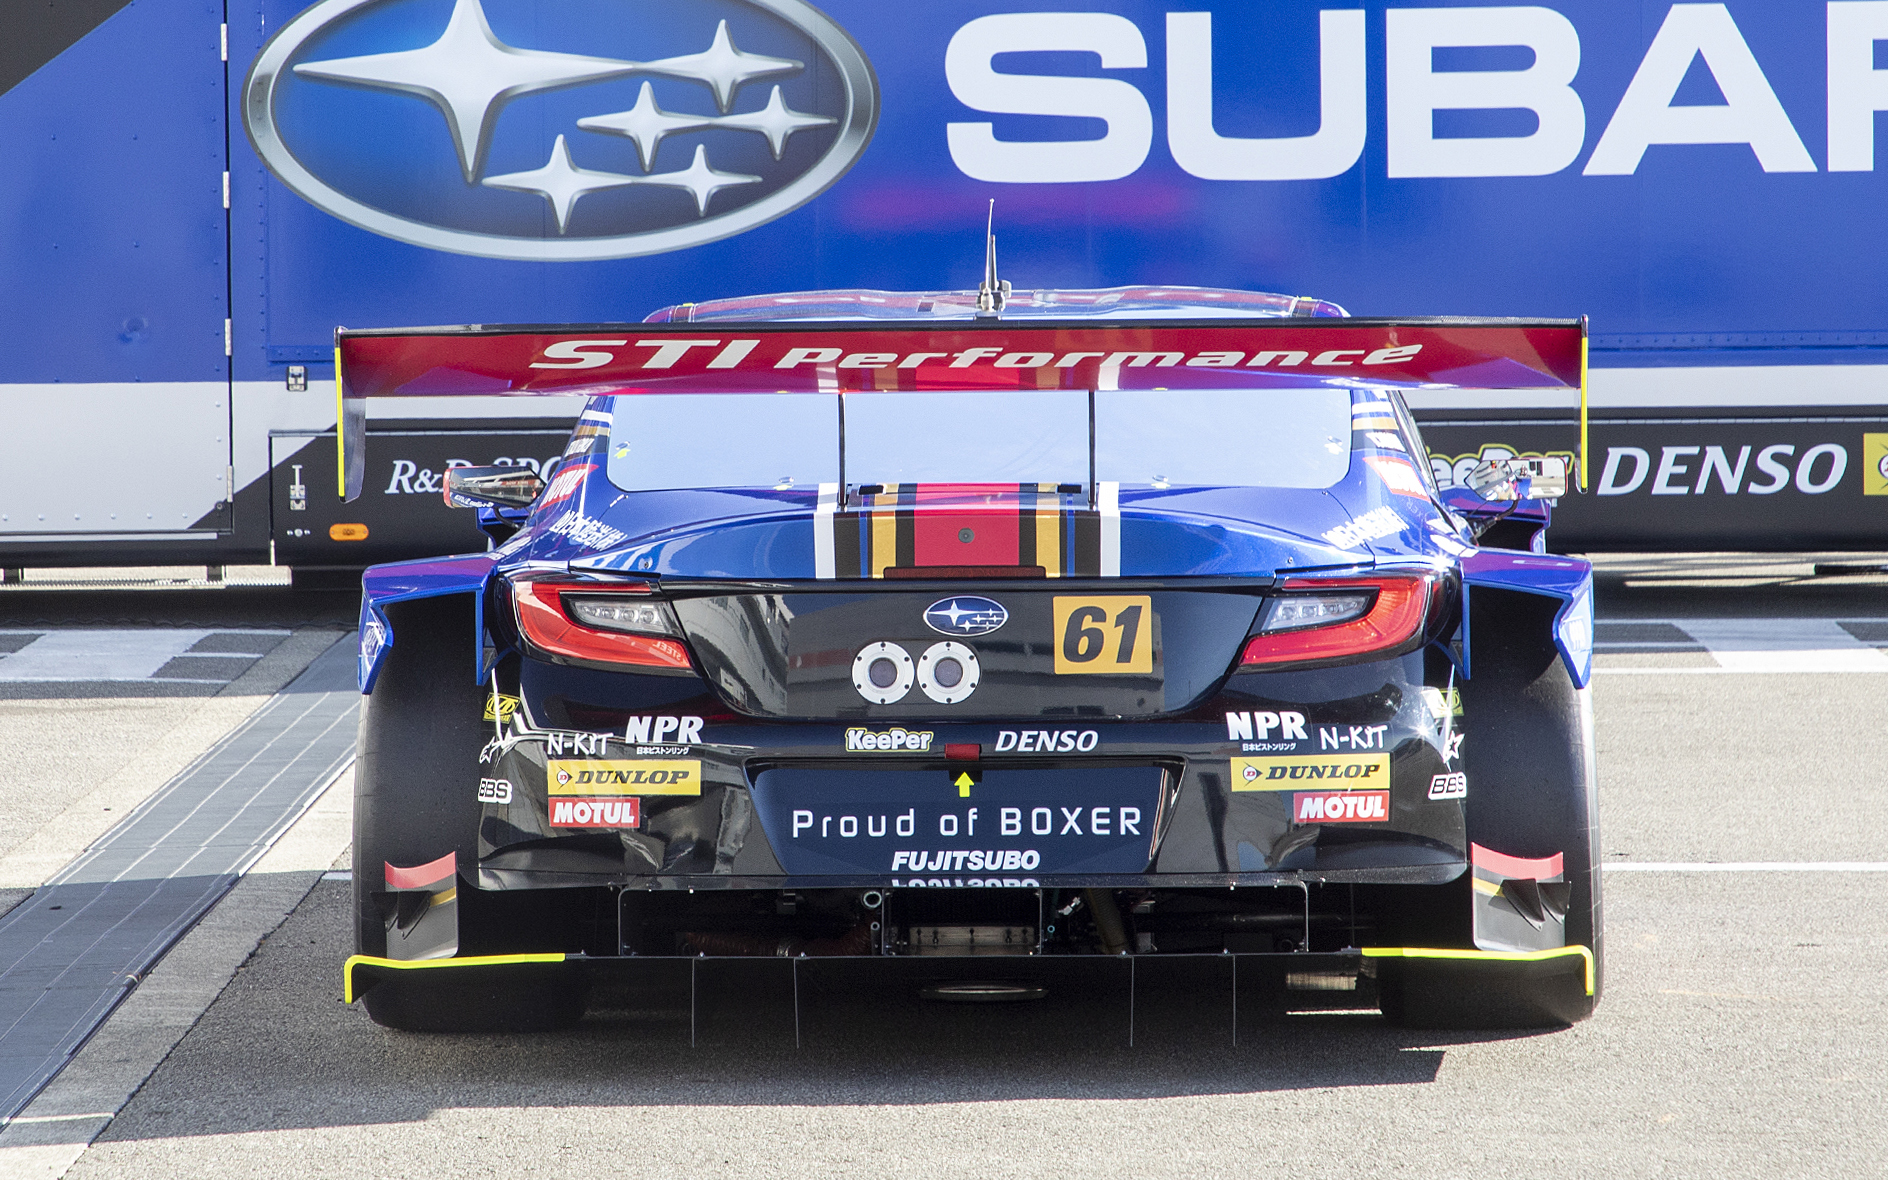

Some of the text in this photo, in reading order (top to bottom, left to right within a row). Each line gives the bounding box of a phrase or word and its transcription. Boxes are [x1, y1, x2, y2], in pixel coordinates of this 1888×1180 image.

[528, 340, 1424, 369] STI Performance
[1596, 443, 1848, 495] DENSO
[1062, 605, 1143, 664] 61
[625, 716, 704, 744] NPR
[1226, 711, 1308, 741] NPR
[847, 728, 932, 751] KeePer
[995, 730, 1099, 752] DENSO
[1242, 743, 1296, 751] 日本ピストンリング
[636, 747, 689, 755] 日本ピストンリング
[575, 770, 689, 784] DUNLOP
[1265, 764, 1380, 780] DUNLOP
[478, 779, 510, 801] BBS
[1430, 774, 1465, 797] BBS
[553, 802, 634, 824] MOTUL
[1300, 796, 1385, 818] MOTUL
[792, 807, 1142, 838] Proud of BOXER
[891, 850, 1040, 871] FUJITSUBO
